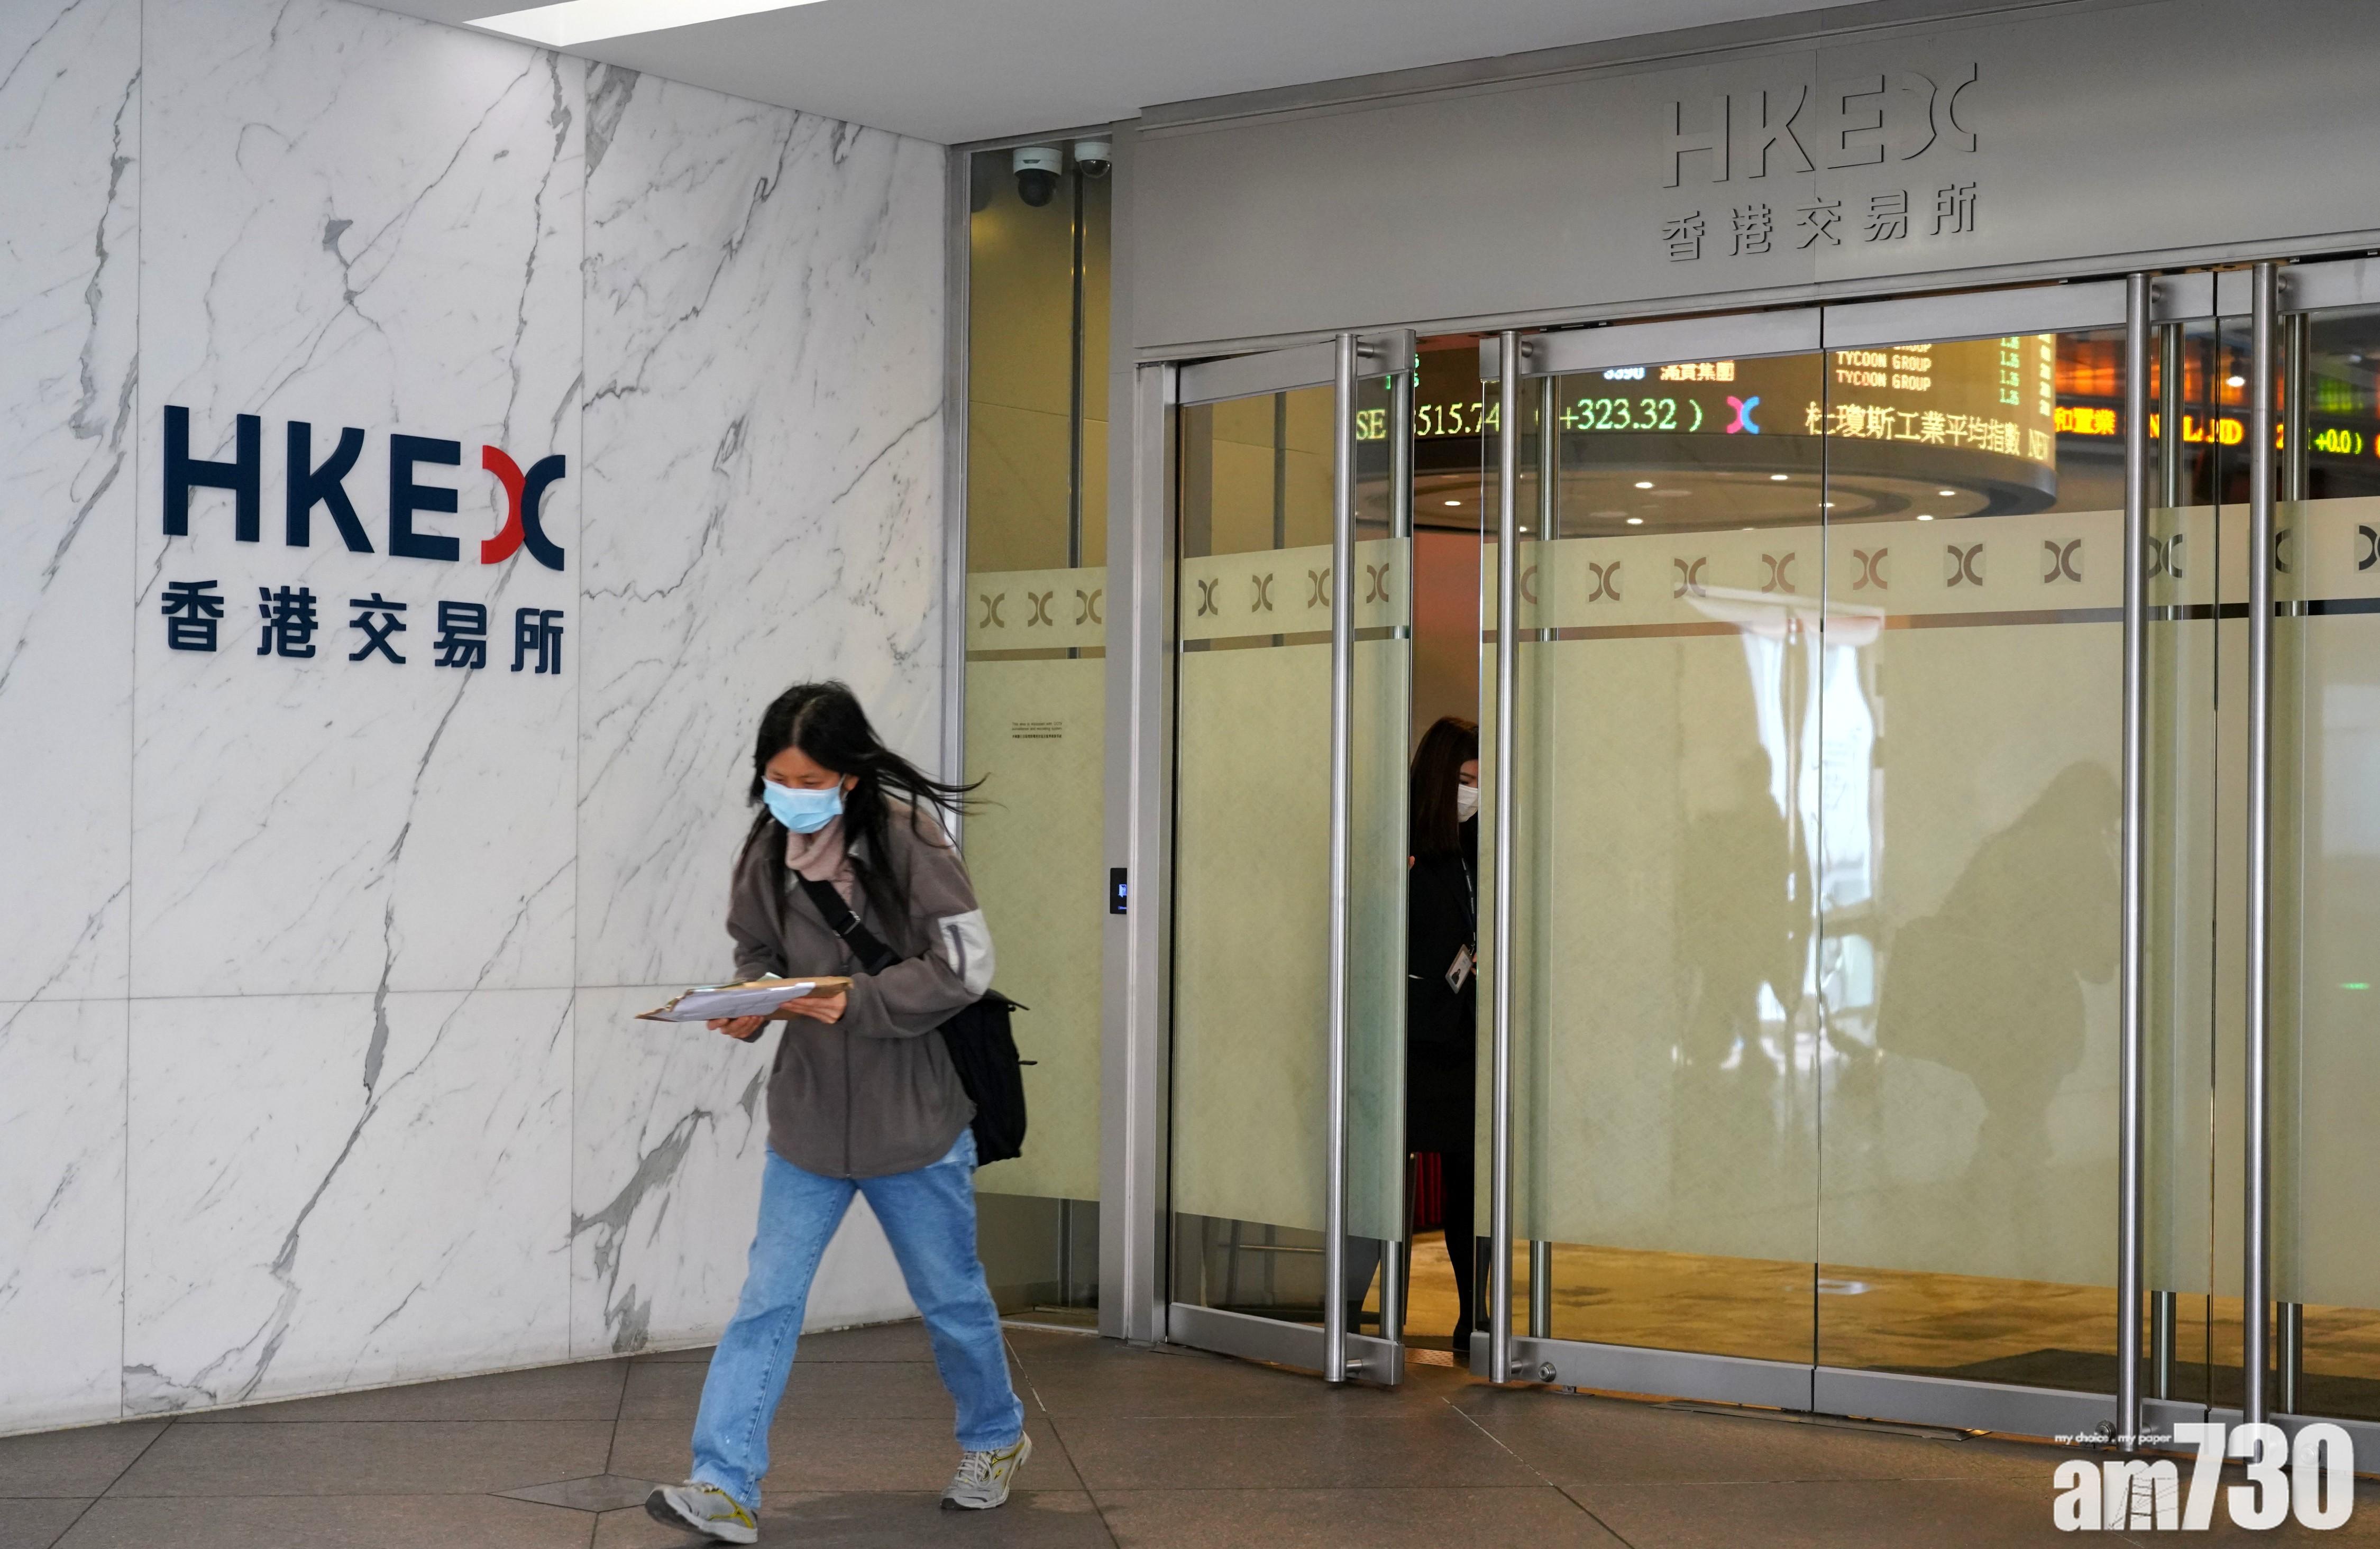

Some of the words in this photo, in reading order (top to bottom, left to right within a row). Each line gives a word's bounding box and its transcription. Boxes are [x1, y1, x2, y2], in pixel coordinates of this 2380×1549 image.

[1662, 182, 1976, 262] 香港交易所
[1836, 351, 1887, 368] TYCOON
[1892, 354, 1932, 372] GROUP
[1836, 369, 1887, 388] TYCOON
[1892, 374, 1932, 391] GROUP
[1414, 402, 1500, 436] 515.74
[162, 405, 566, 571] HKEX
[161, 580, 564, 675] 香港交易所
